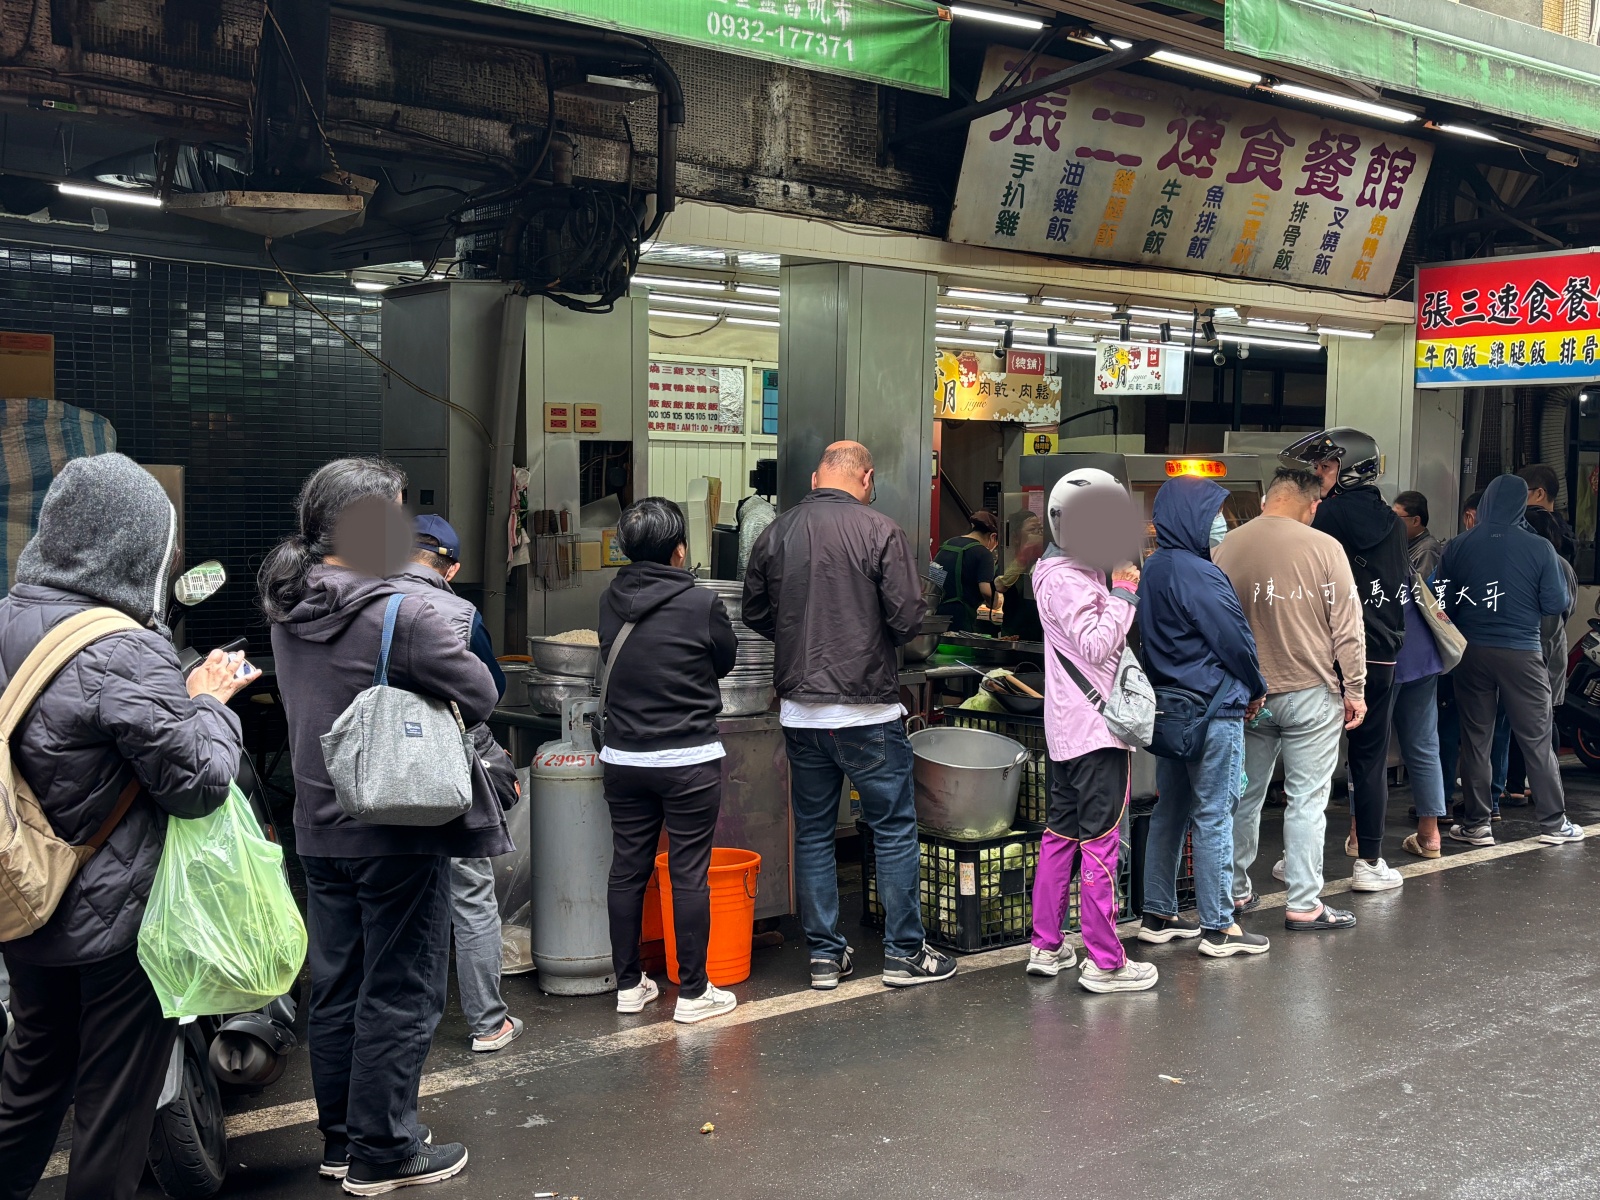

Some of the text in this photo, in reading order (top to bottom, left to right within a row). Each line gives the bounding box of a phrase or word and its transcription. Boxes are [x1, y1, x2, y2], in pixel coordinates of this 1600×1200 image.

[707, 11, 853, 62] 0932-177371
[995, 152, 1035, 237] 手扒雞
[1045, 159, 1086, 243] 油雞飯
[1093, 168, 1137, 249] 雞腿飯
[1141, 178, 1183, 255] 牛肉飯
[1186, 185, 1225, 260] 魚排飯
[1231, 193, 1271, 266] 三寶飯
[1272, 200, 1310, 271] 排骨飯
[1311, 206, 1350, 276] 叉燒飯
[1351, 213, 1389, 282] 燒鴨飯
[1421, 275, 1600, 330] 張三速食餐
[1424, 334, 1599, 372] 牛肉飯 雞腿飯 排骨
